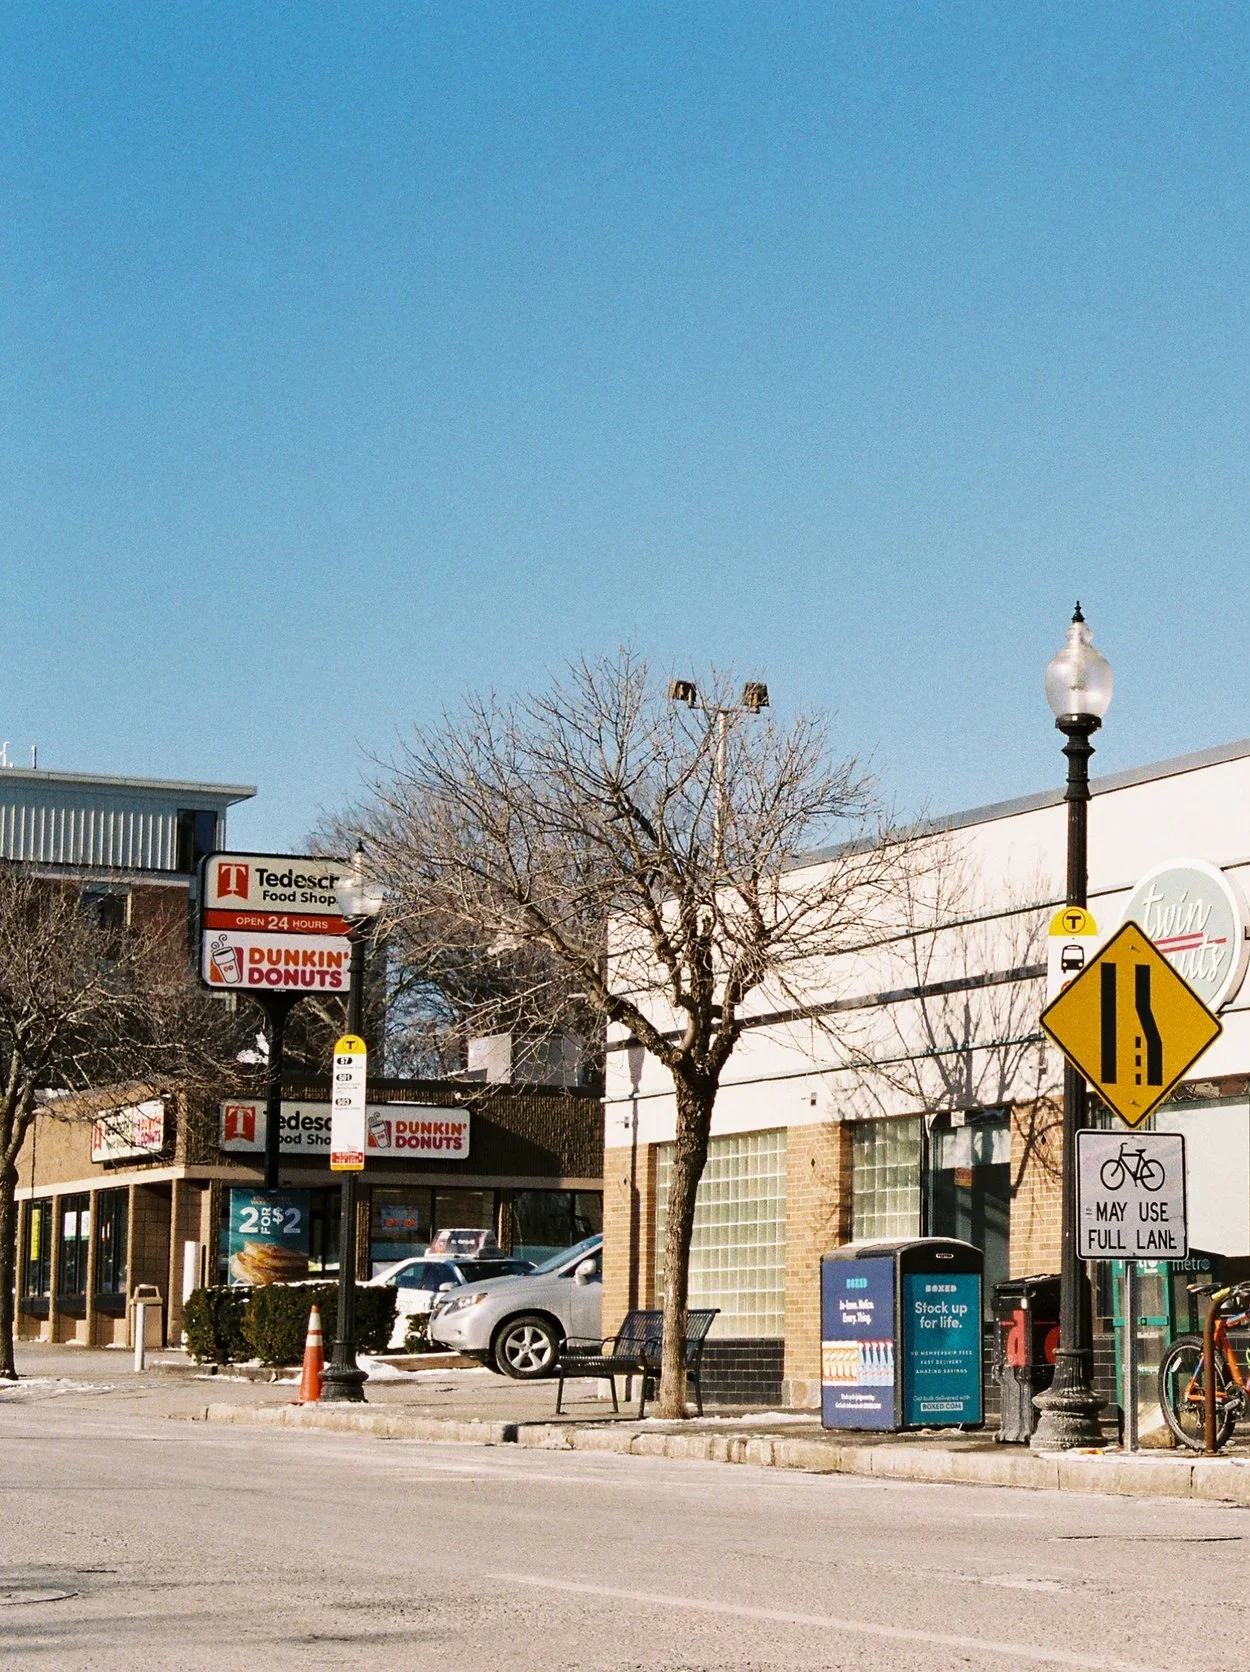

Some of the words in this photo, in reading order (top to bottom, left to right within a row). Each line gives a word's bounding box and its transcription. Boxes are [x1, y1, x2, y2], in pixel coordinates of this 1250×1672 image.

[263, 890, 296, 902] Food
[300, 892, 338, 906] Shop
[1143, 883, 1213, 939] twin
[236, 917, 265, 927] OPEN
[267, 916, 289, 930] 24
[292, 919, 329, 930] HOURS
[1066, 915, 1082, 930] T
[248, 947, 349, 968] DUNKIN'
[247, 967, 343, 988] DONUTS
[345, 1040, 356, 1050] T
[395, 1120, 467, 1136] DUNKIN'
[395, 1135, 463, 1150] DONUTS
[1096, 1201, 1128, 1222] MAY
[1139, 1202, 1169, 1222] USE
[238, 1206, 259, 1234] 2
[260, 1207, 272, 1235] FOR
[1088, 1229, 1127, 1250] FULL
[1136, 1229, 1177, 1250] LANE
[925, 1284, 957, 1293] BOXED
[915, 1301, 949, 1315] Stock
[951, 1304, 968, 1317] up
[919, 1316, 938, 1329] for
[940, 1315, 963, 1329] life.
